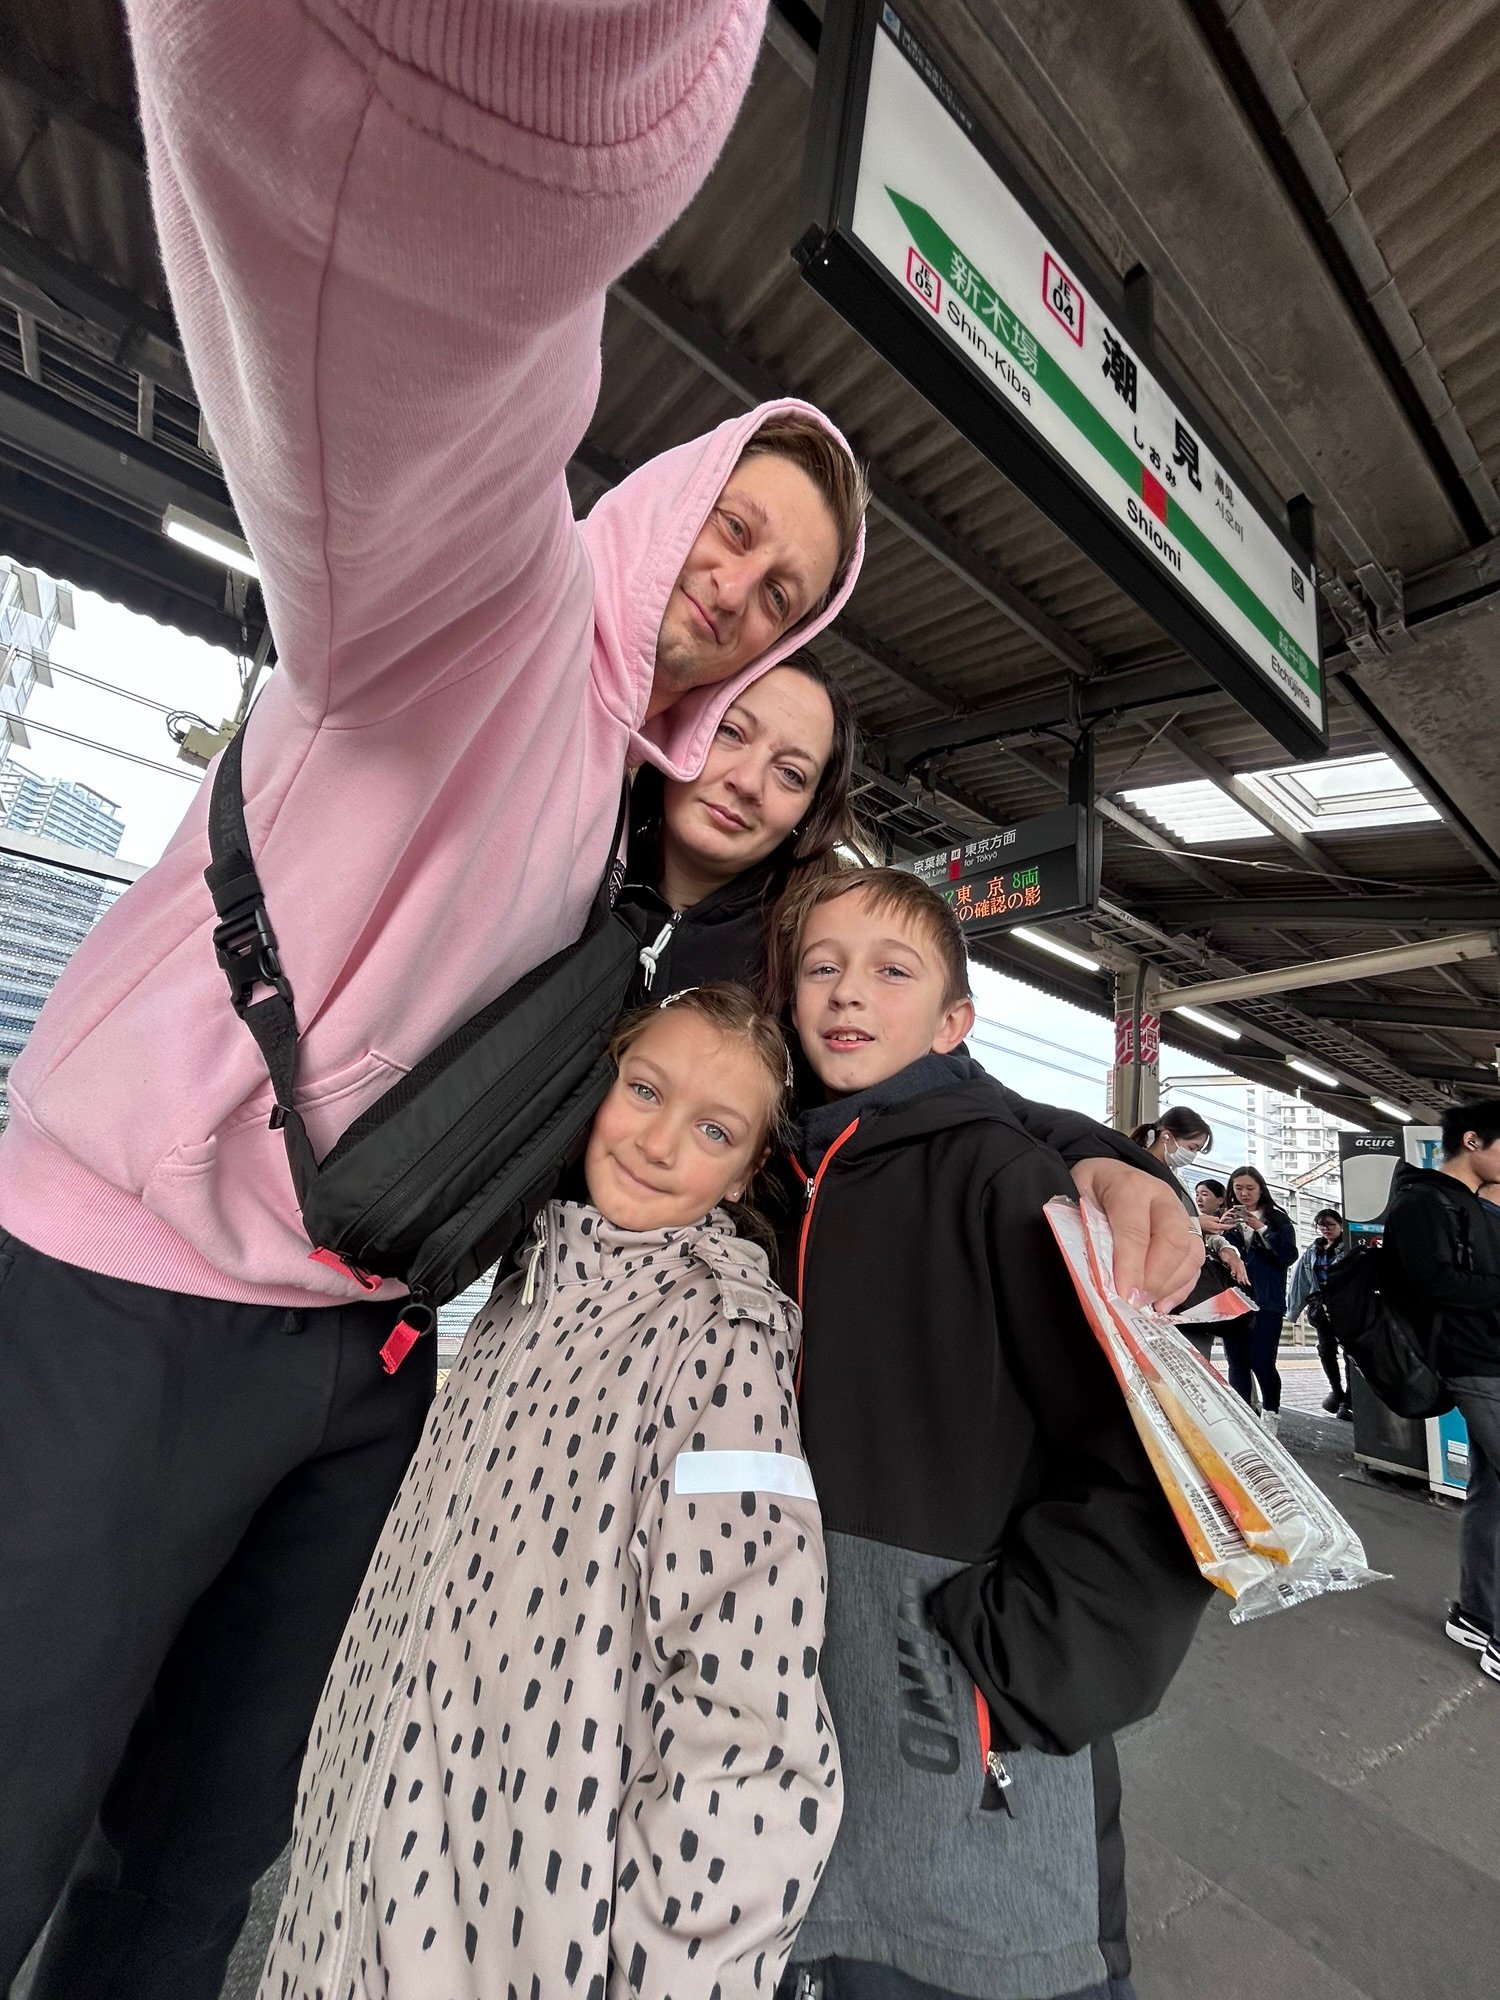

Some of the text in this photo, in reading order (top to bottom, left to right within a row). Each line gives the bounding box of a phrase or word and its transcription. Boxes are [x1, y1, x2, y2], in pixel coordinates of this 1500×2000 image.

[915, 272, 933, 298] 05
[1057, 277, 1072, 302] JE
[950, 250, 1038, 376] 新木場
[1053, 288, 1075, 326] 04
[947, 300, 1031, 407] Shin-Kiba
[1133, 425, 1177, 487] しおみ
[1126, 497, 1182, 572] Shiomi
[964, 829, 1017, 858] 東京方面
[913, 852, 947, 874] 京葉線
[964, 859, 974, 867] for
[1012, 865, 1039, 889] 8両
[1355, 1139, 1396, 1147] acure
[1254, 1492, 1280, 1524] 257433
